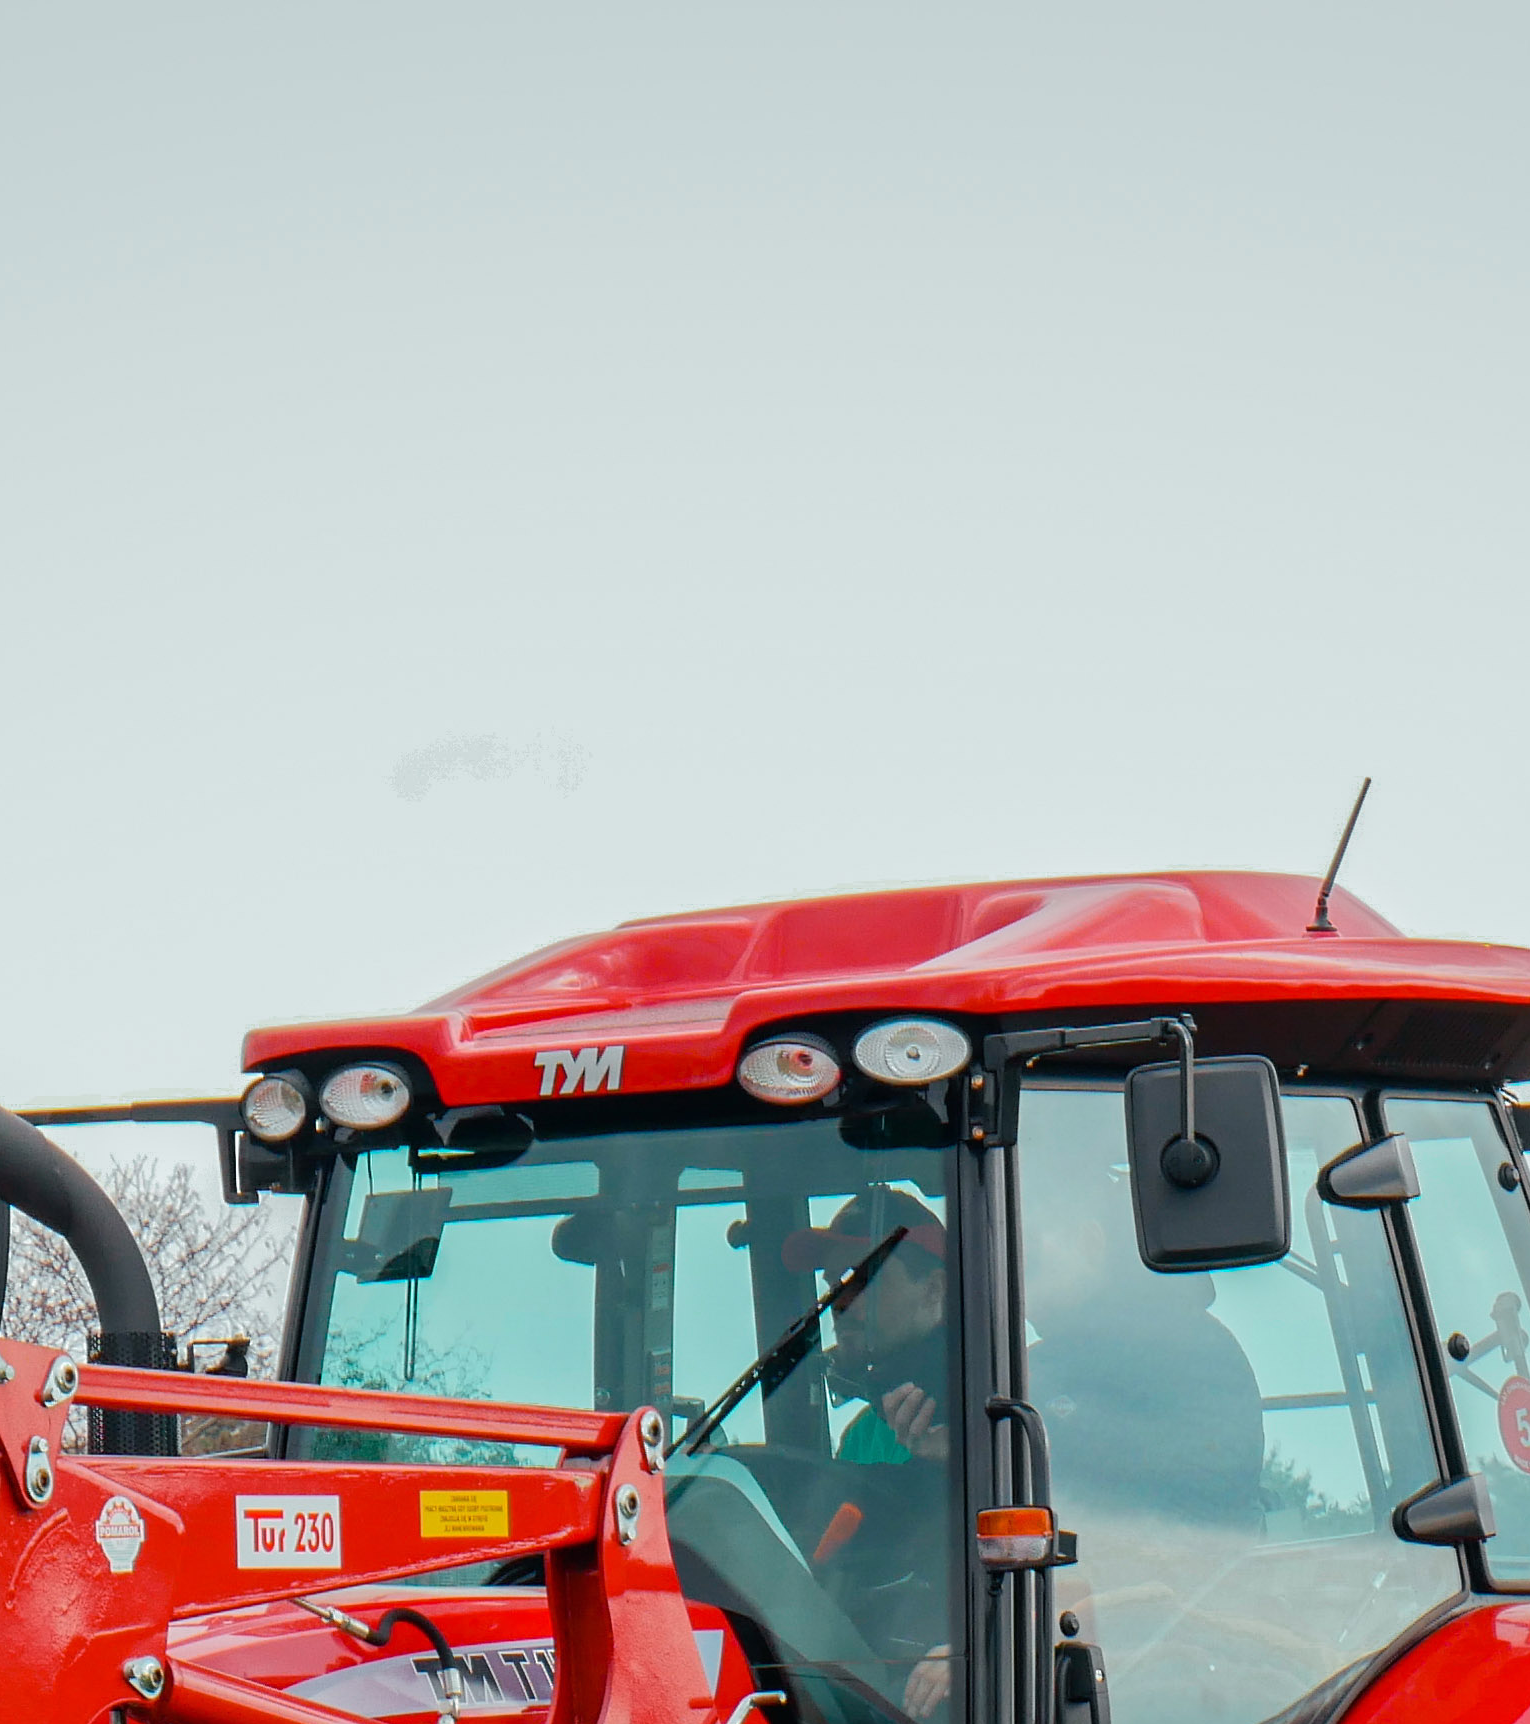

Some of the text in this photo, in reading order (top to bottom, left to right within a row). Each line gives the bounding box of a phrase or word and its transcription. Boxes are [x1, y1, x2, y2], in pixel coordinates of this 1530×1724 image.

[534, 1044, 625, 1097] TYM
[243, 1508, 334, 1553] Tur 230
